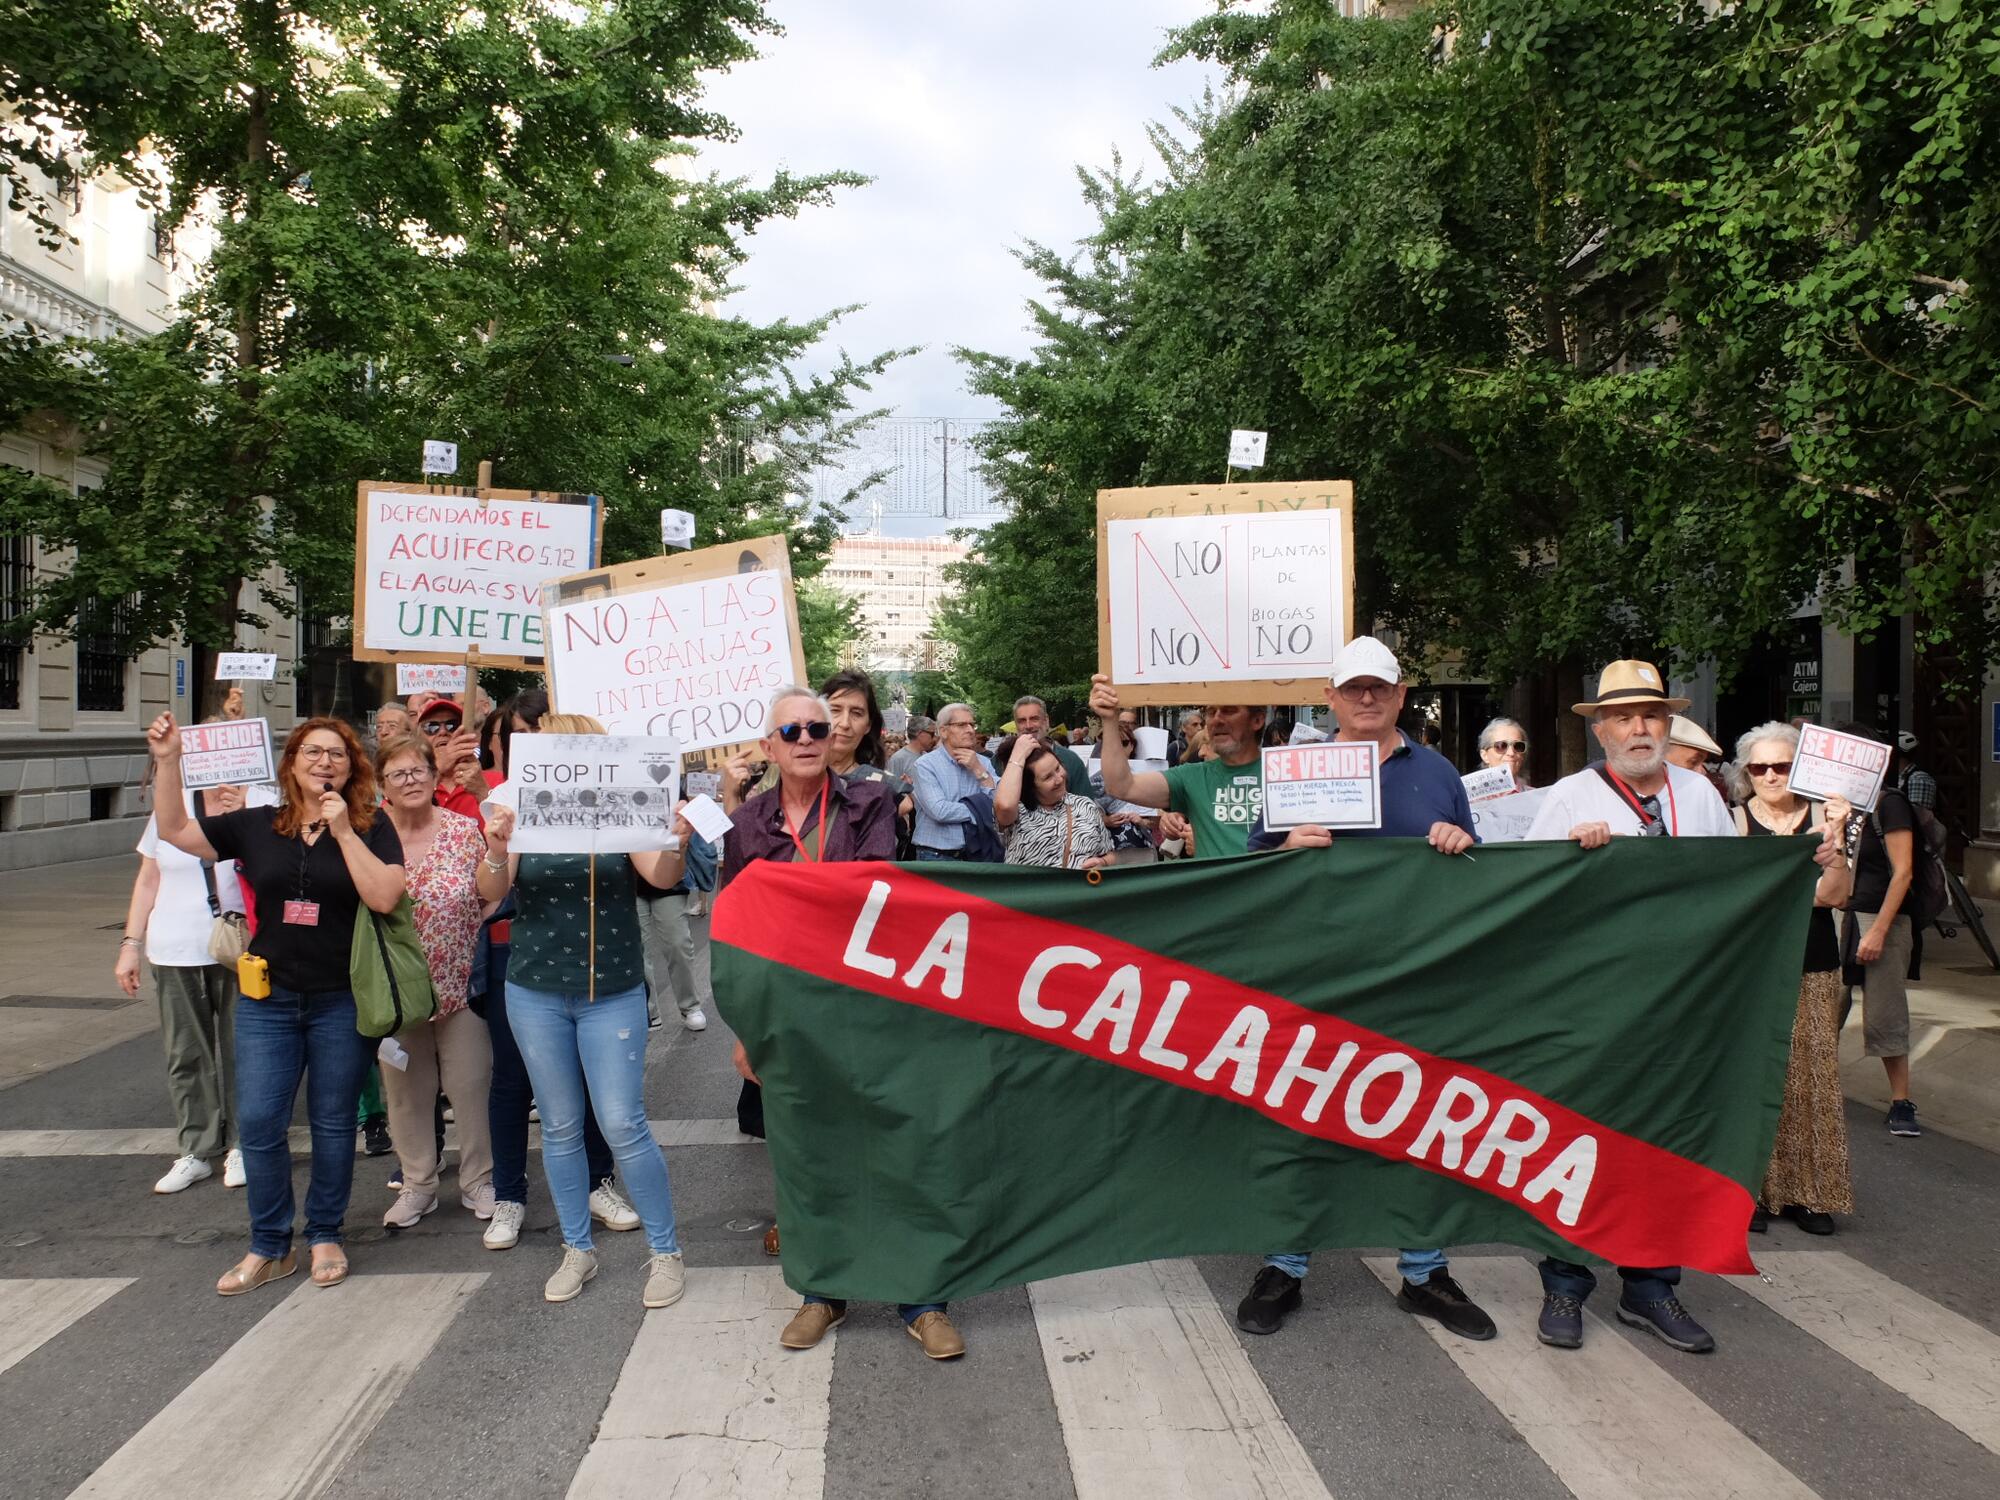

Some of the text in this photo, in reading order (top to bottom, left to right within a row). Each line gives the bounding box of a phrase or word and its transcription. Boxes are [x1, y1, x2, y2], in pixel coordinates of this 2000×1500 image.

[381, 503, 550, 529] DEFENDAMOS EL
[1175, 541, 1222, 577] NO
[1252, 545, 1327, 560] PLANTAS
[1278, 571, 1297, 583] DE
[1252, 606, 1315, 621] BIOGAS
[625, 627, 772, 676] GRANJAS
[1151, 628, 1200, 666] NO
[1256, 624, 1313, 657] NO
[1793, 661, 1818, 677] ATM
[596, 661, 783, 716] INTENSIVAS
[1793, 680, 1818, 694] Cajero
[181, 723, 263, 753] SE VENDE
[1804, 730, 1829, 757] SE
[1832, 737, 1887, 773] VENDE
[522, 764, 619, 783] STOP IT
[1267, 748, 1371, 781] SE VENDE
[843, 880, 1597, 1227] LA CALAHORRA
